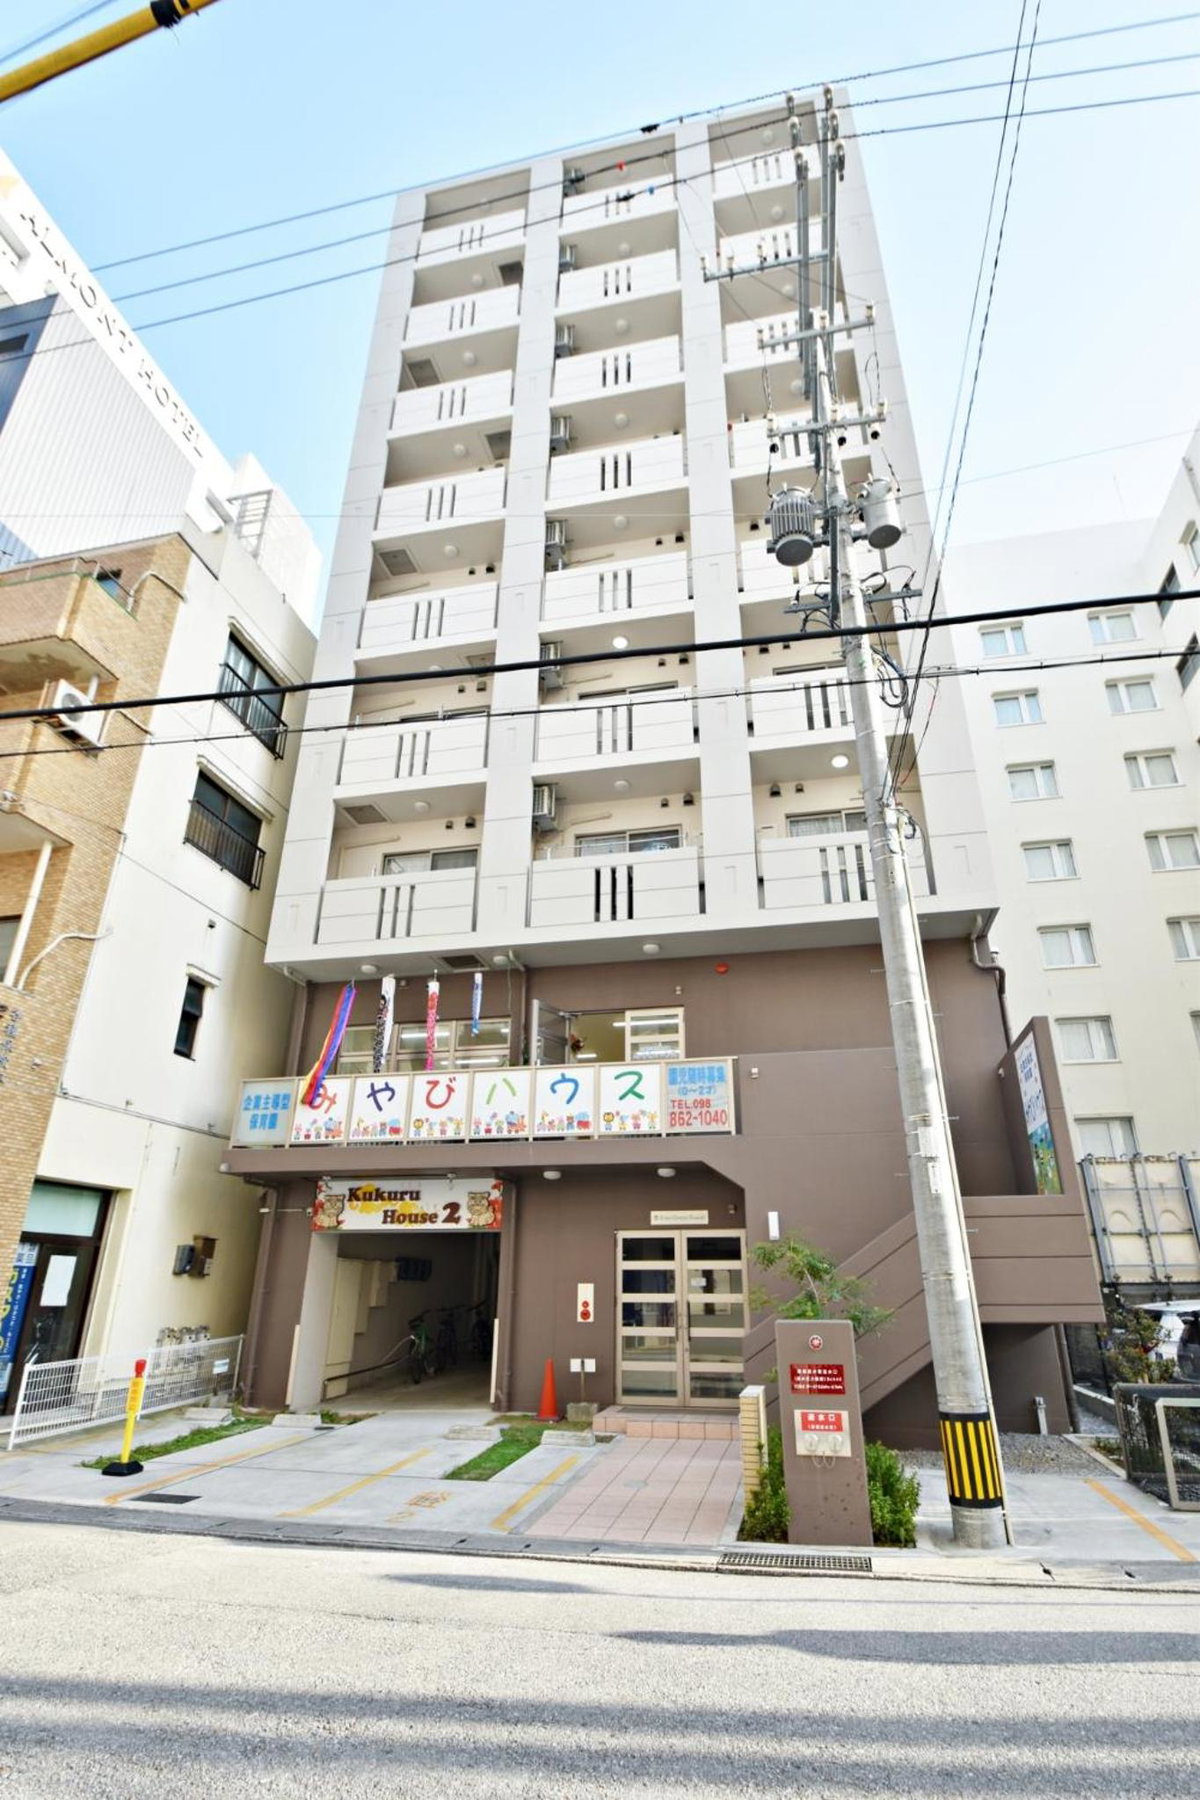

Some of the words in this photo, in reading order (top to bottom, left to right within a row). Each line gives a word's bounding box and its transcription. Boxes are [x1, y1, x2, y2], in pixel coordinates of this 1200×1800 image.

[670, 1109, 728, 1127] 862-1040
[347, 1187, 421, 1203] Kukuru
[381, 1209, 438, 1225] House
[441, 1202, 461, 1225] 2
